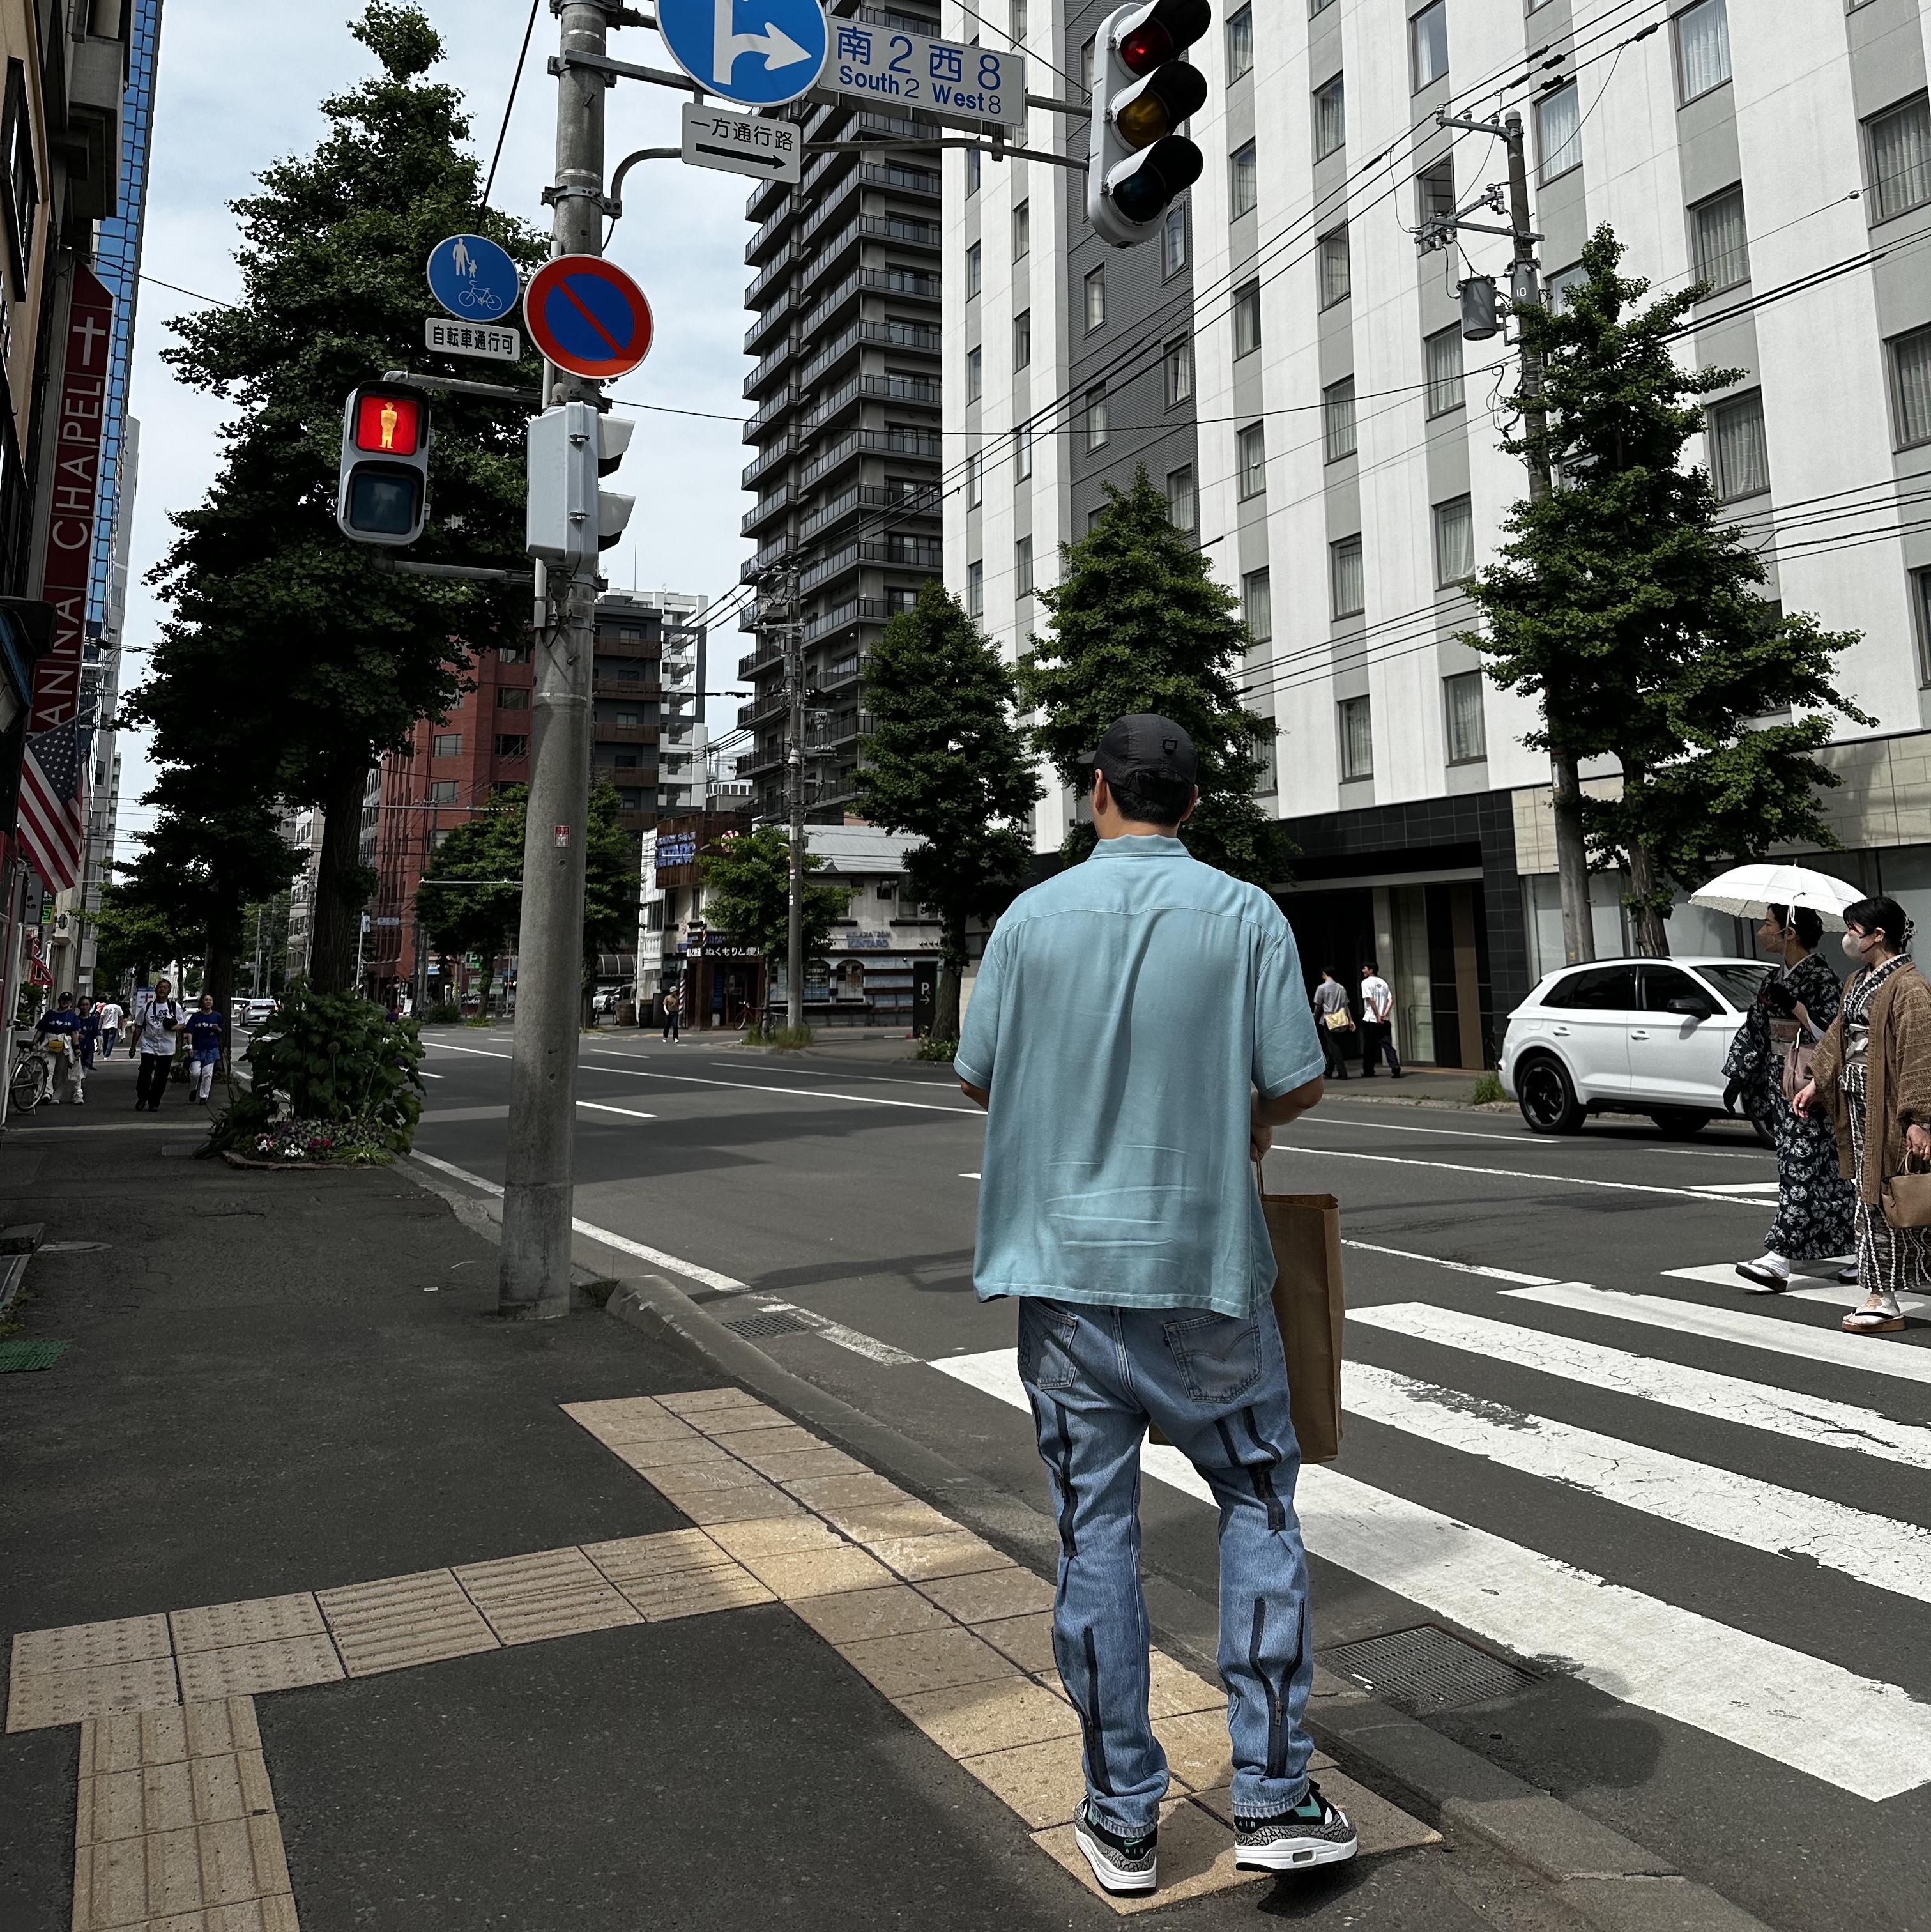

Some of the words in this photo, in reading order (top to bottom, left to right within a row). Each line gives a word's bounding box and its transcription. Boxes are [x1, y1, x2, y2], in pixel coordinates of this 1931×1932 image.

[839, 65, 899, 95] South
[931, 83, 984, 112] West
[690, 118, 793, 151] 一方通行路
[433, 325, 514, 355] 自転車通行可
[52, 381, 102, 550] CHAPEL
[921, 982, 930, 995] P
